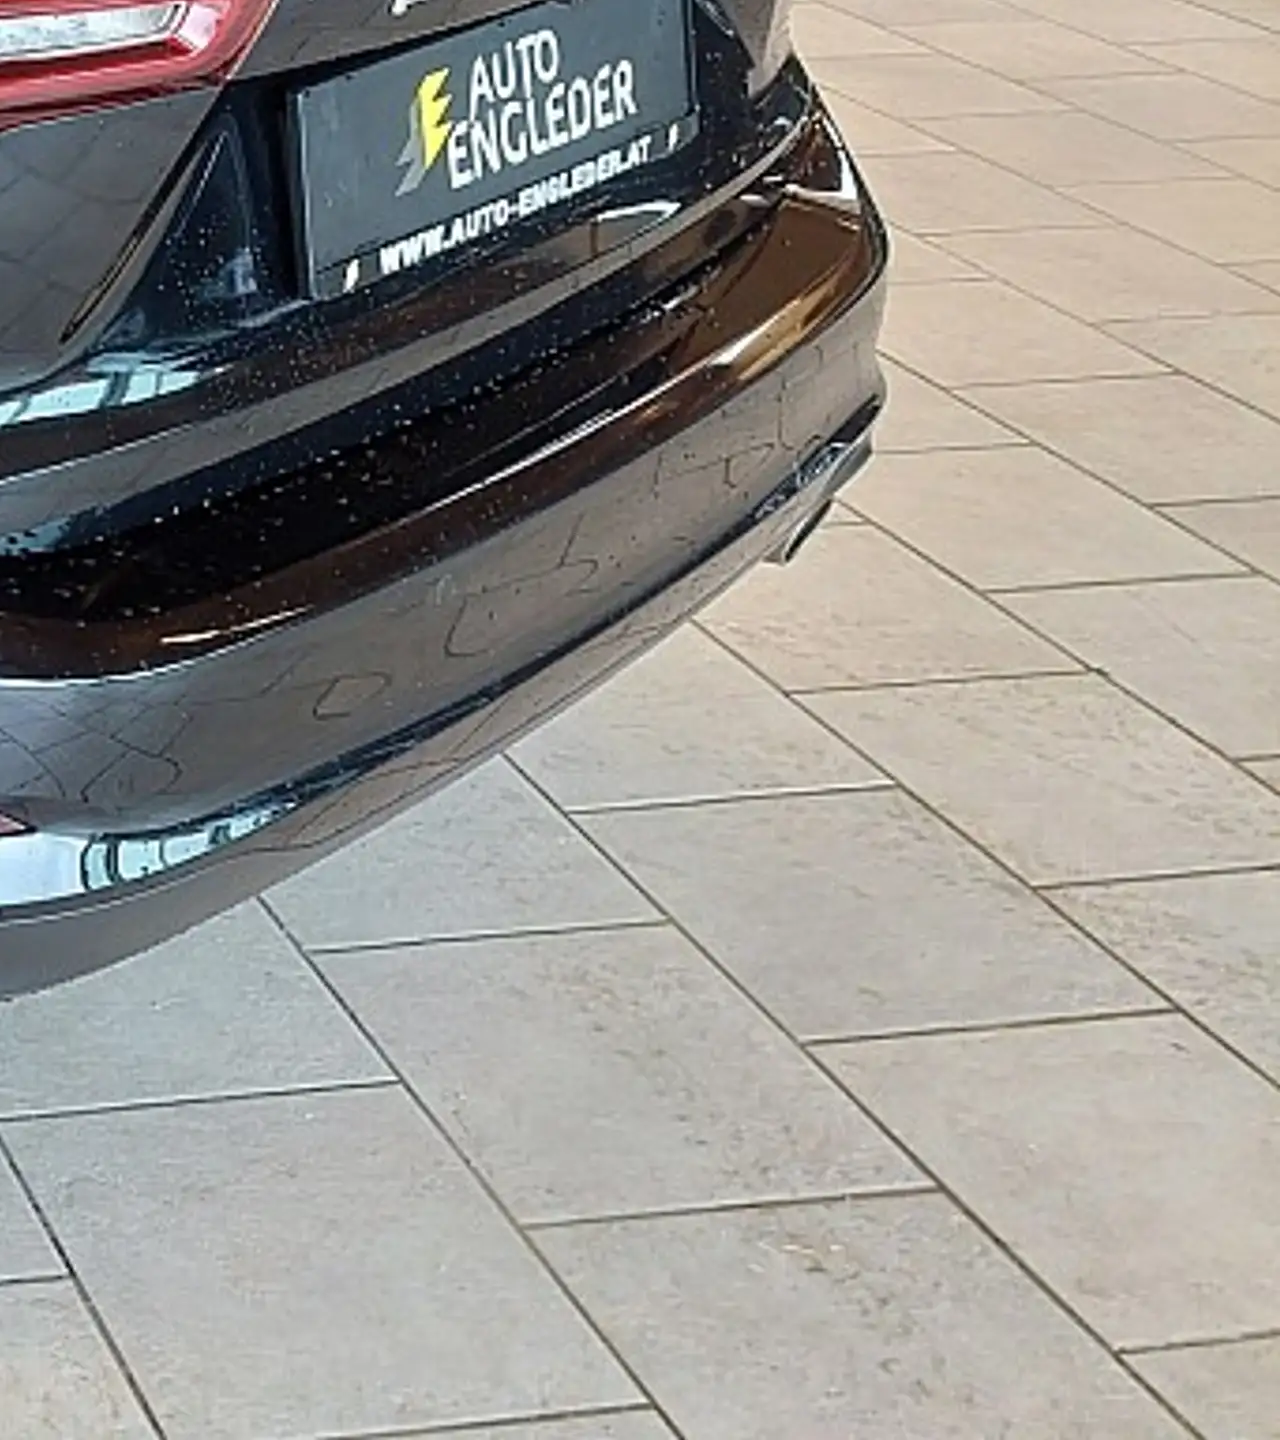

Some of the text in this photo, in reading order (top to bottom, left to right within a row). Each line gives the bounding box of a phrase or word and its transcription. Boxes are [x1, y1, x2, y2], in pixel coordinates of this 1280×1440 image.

[446, 59, 638, 190] ENGLEDER
[469, 29, 561, 119] AUTO
[379, 136, 653, 275] WWW.AUTO-ENGLEDER.AT
